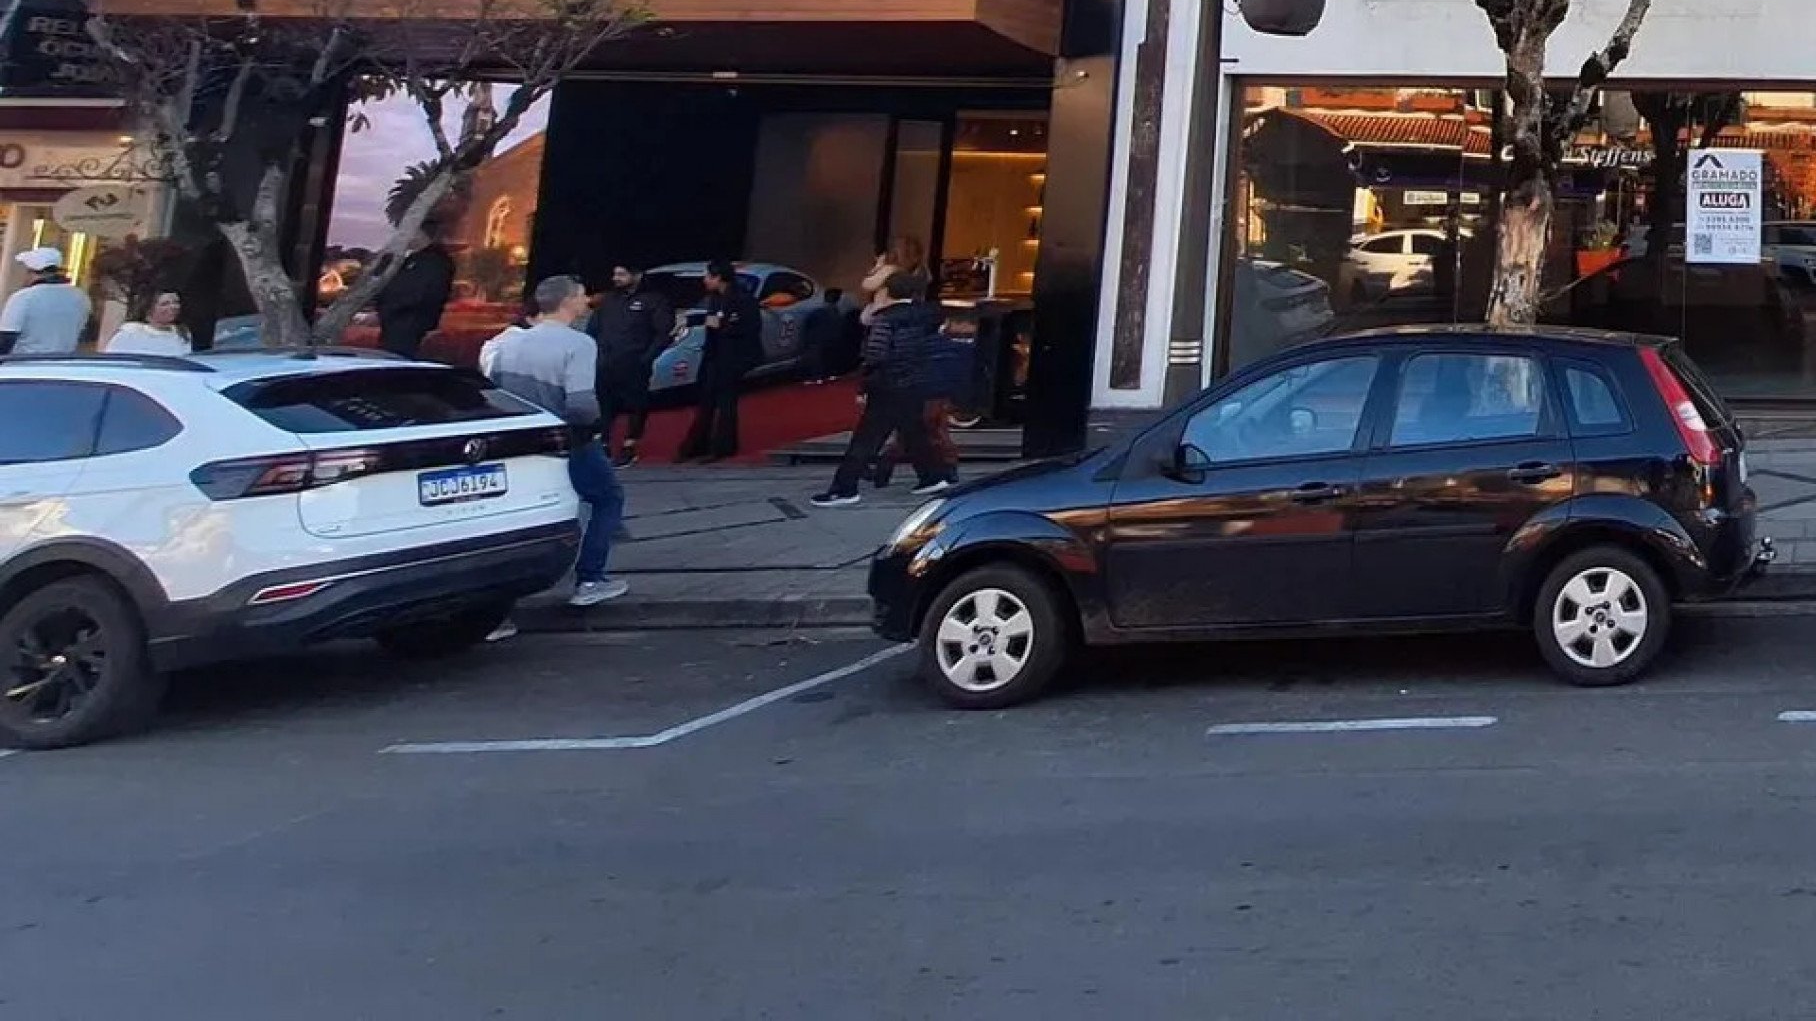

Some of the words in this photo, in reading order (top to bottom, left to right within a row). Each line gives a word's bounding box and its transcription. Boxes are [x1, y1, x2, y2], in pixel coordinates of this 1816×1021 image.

[1580, 146, 1653, 168] Steffens
[1692, 169, 1758, 180] GRAMADO
[1702, 193, 1746, 207] ALUGA
